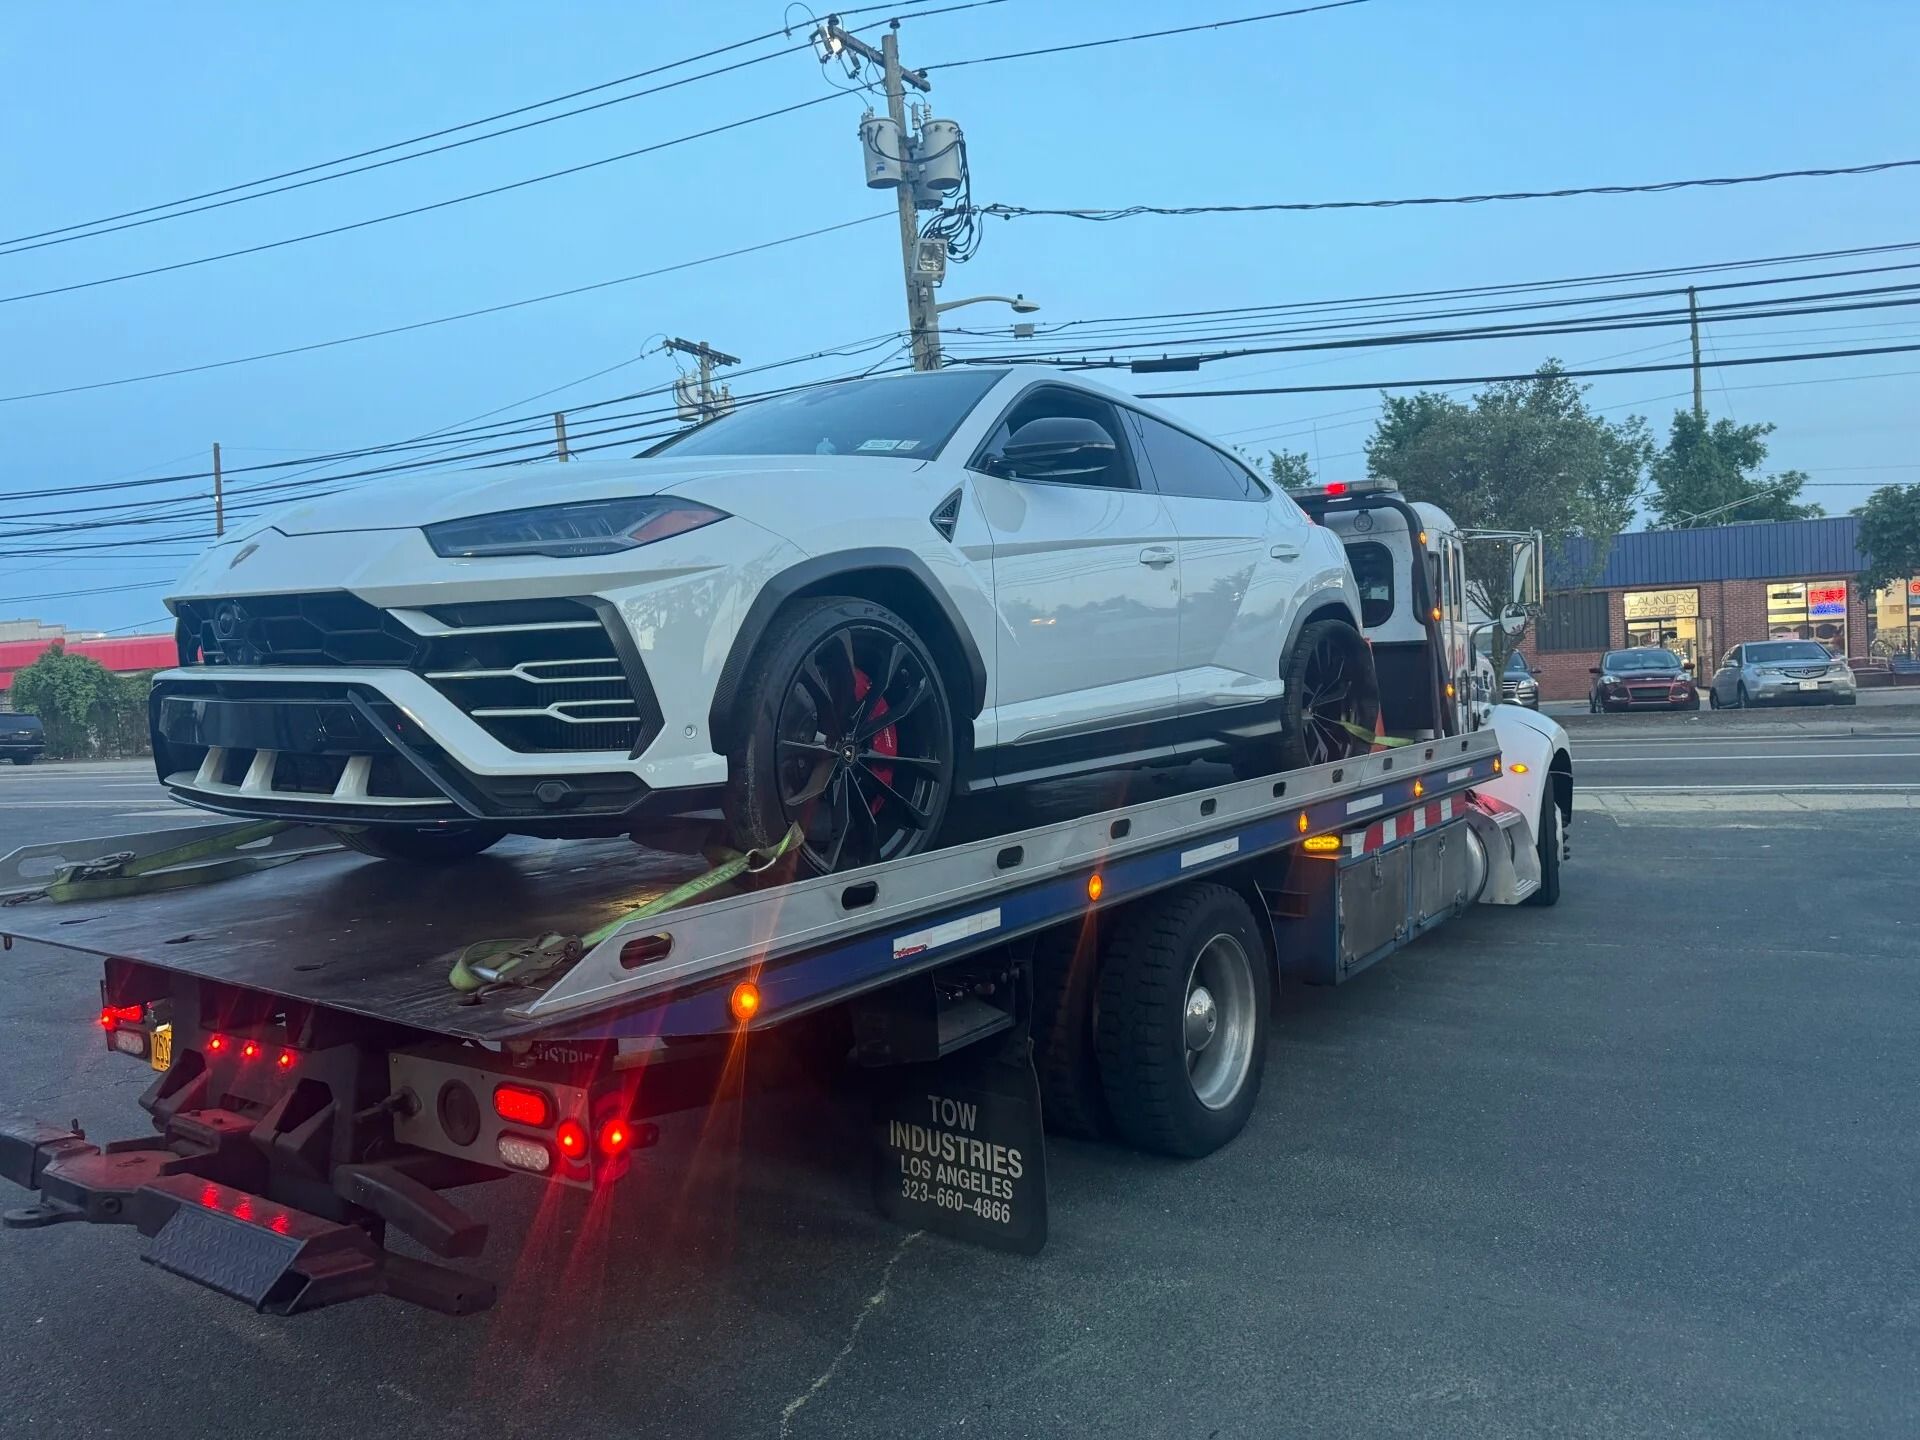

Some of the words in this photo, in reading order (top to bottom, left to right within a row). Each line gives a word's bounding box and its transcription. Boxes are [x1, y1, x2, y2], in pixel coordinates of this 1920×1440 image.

[1628, 592, 1696, 608] LAUNDRY
[1629, 604, 1696, 617] EXPRESS
[927, 1094, 977, 1132] TOW
[889, 1119, 1024, 1179] INDUSTRIES
[900, 1154, 932, 1180] LOS
[935, 1163, 1014, 1200] ANGELES
[901, 1178, 1011, 1224] 323-660-4866
